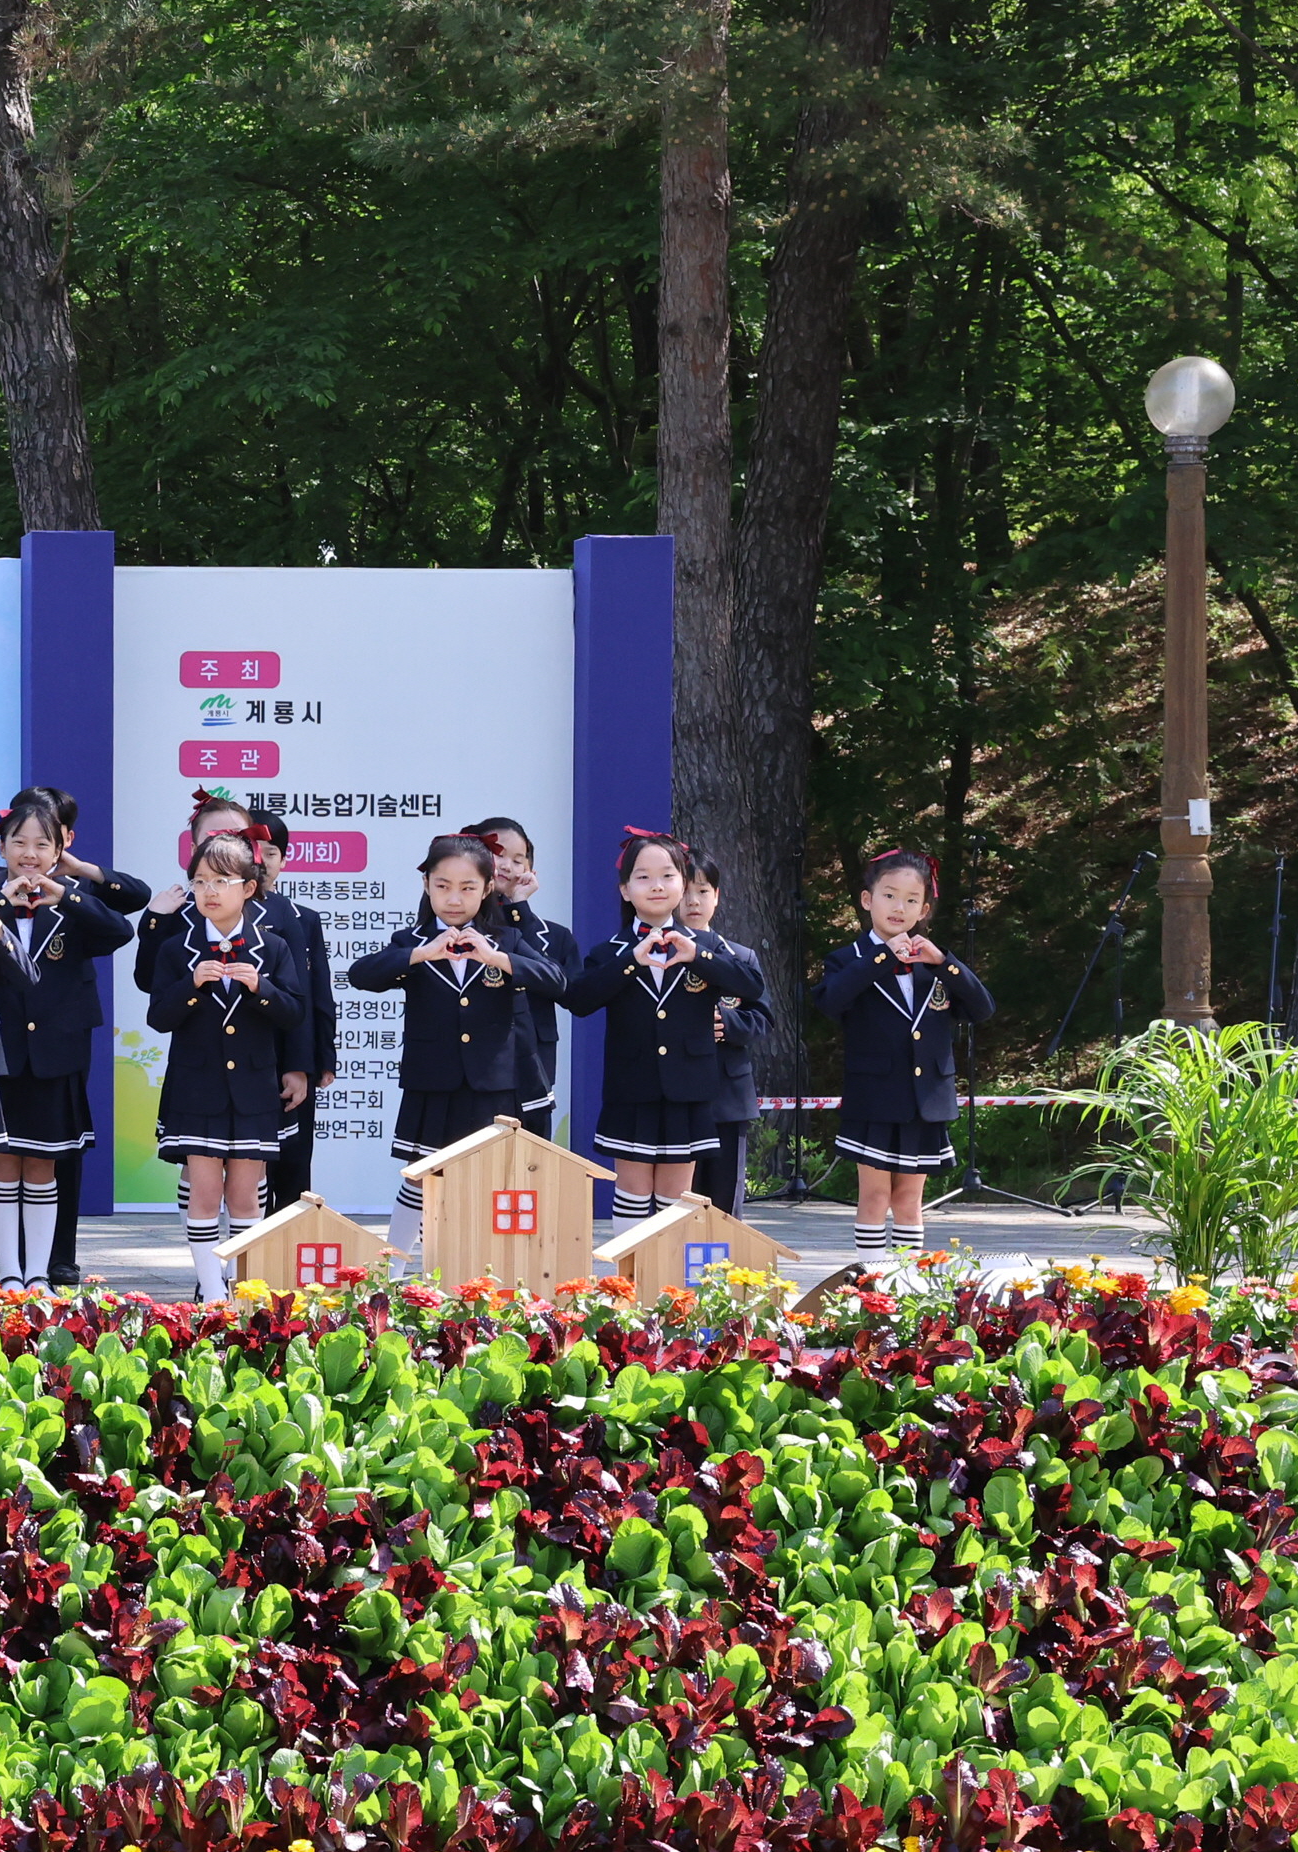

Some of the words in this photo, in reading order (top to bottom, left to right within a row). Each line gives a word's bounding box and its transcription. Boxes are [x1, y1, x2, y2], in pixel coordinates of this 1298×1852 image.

[245, 793, 442, 817] 계룡시농업기술센터
[273, 880, 385, 901] 대학총동문회
[315, 1090, 383, 1109] 험연구회
[314, 1120, 383, 1139] 빵연구회
